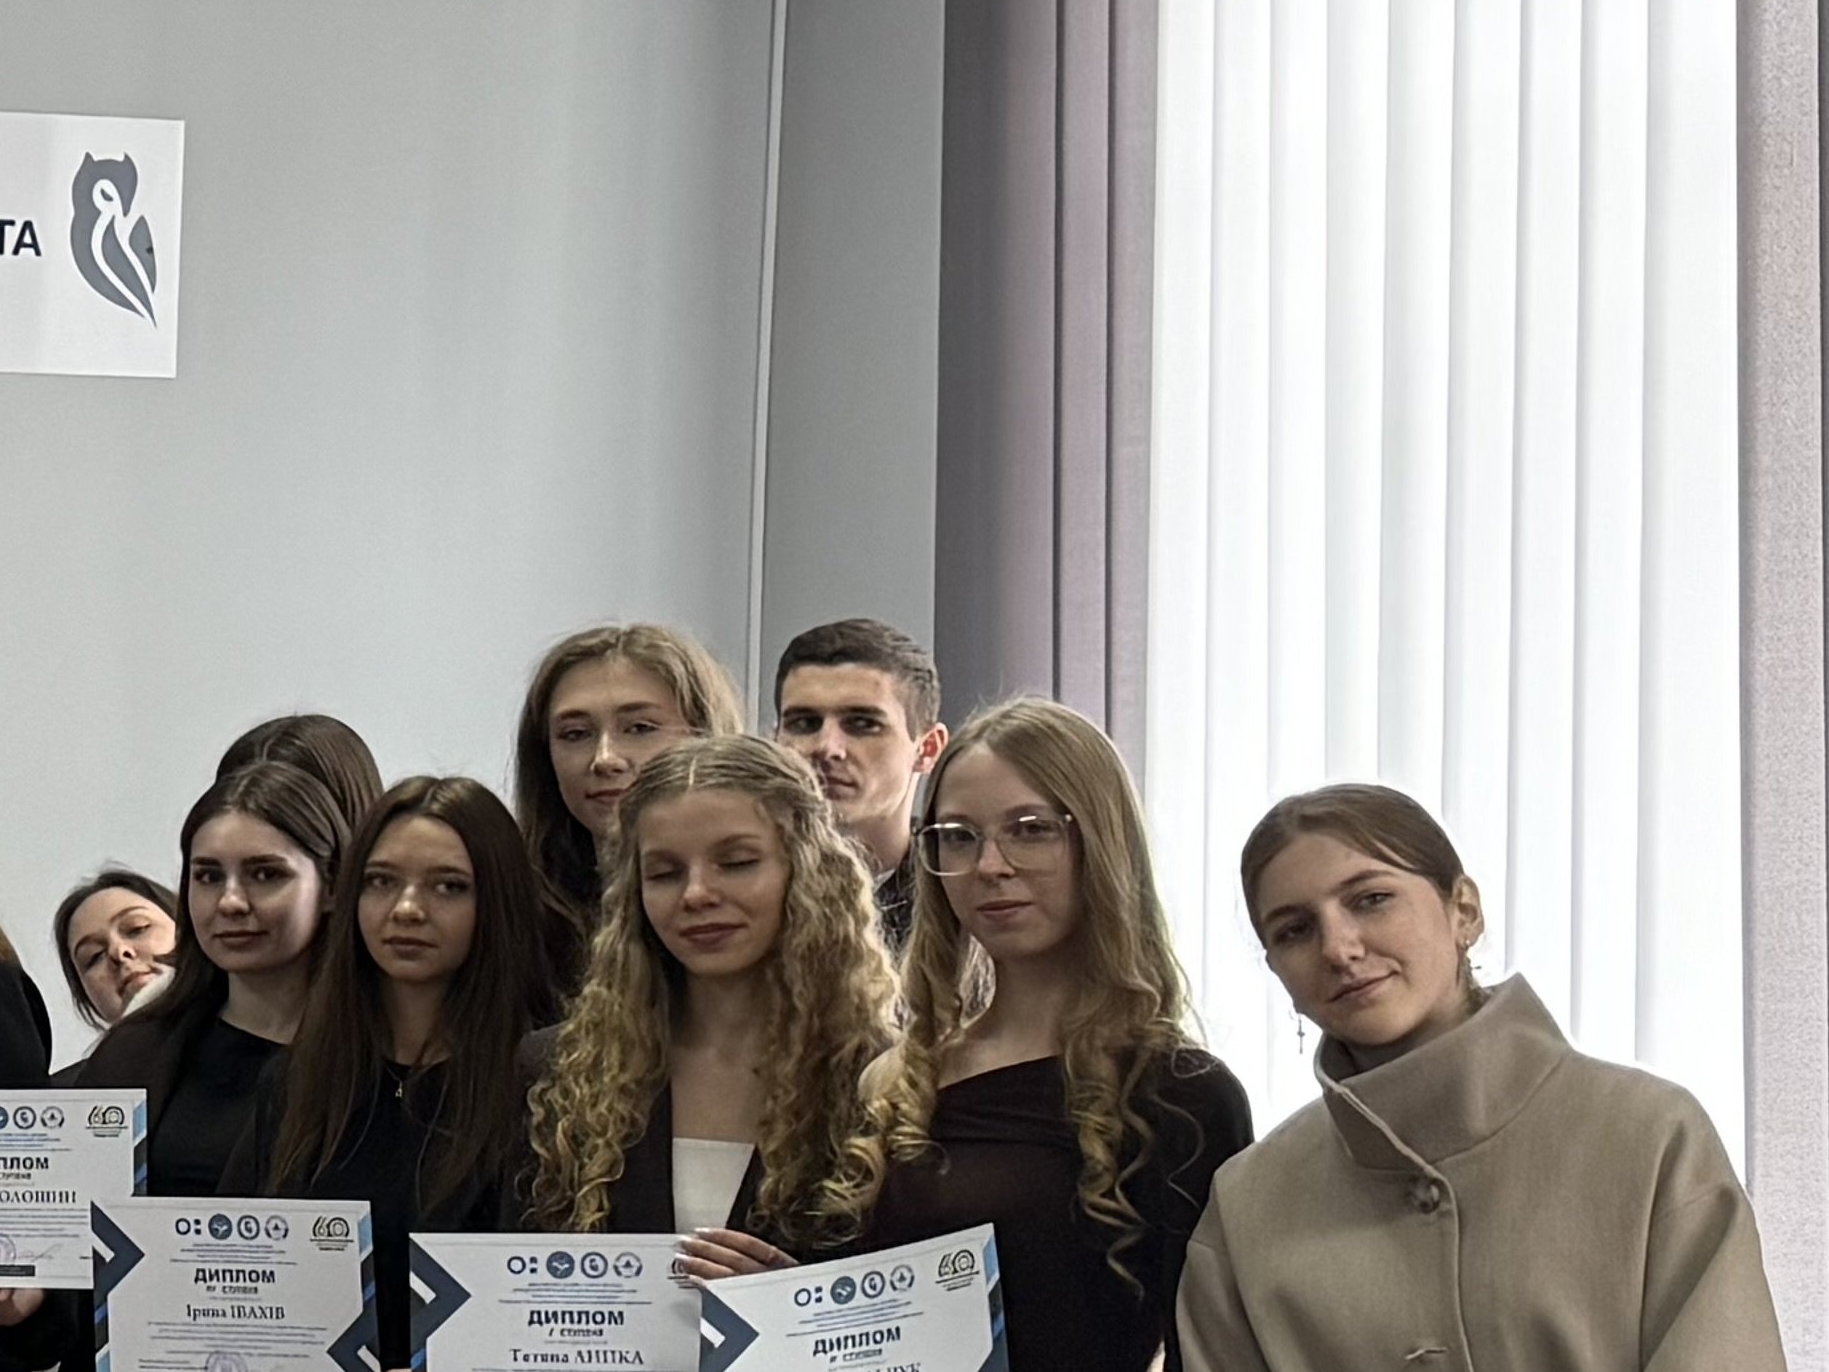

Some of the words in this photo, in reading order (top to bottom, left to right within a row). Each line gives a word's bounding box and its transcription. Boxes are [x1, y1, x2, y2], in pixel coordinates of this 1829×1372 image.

[194, 1267, 276, 1285] ДИПЛОМ
[527, 1309, 624, 1327] ДИПЛОМ
[812, 1325, 902, 1358] ДИПЛОМ
